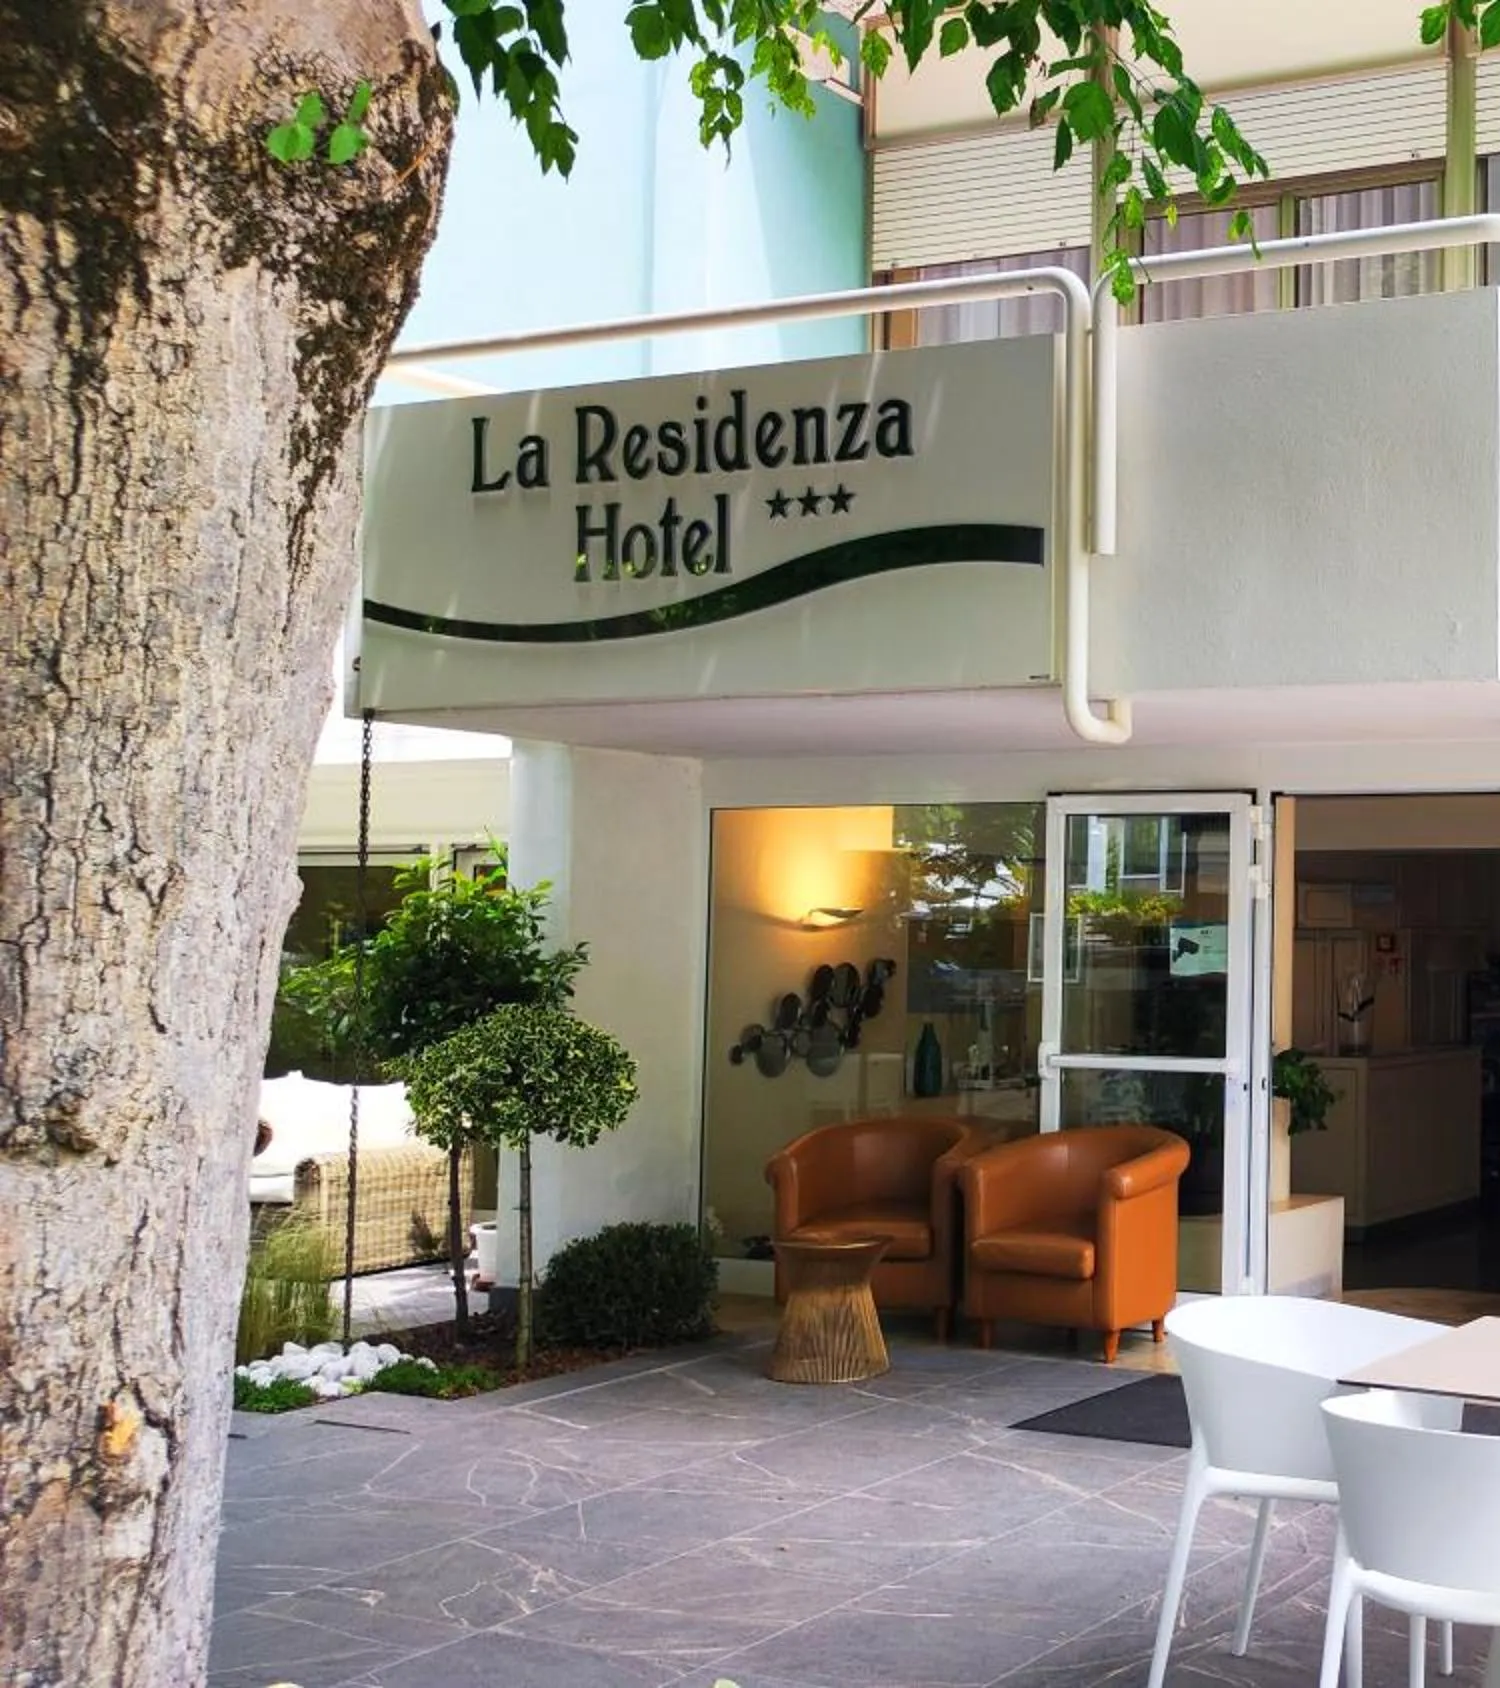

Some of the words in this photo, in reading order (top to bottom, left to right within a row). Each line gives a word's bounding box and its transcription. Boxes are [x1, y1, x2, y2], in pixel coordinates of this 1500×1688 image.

[471, 416, 549, 492] La
[575, 389, 915, 484] Residenza
[574, 493, 732, 582] Hotel
